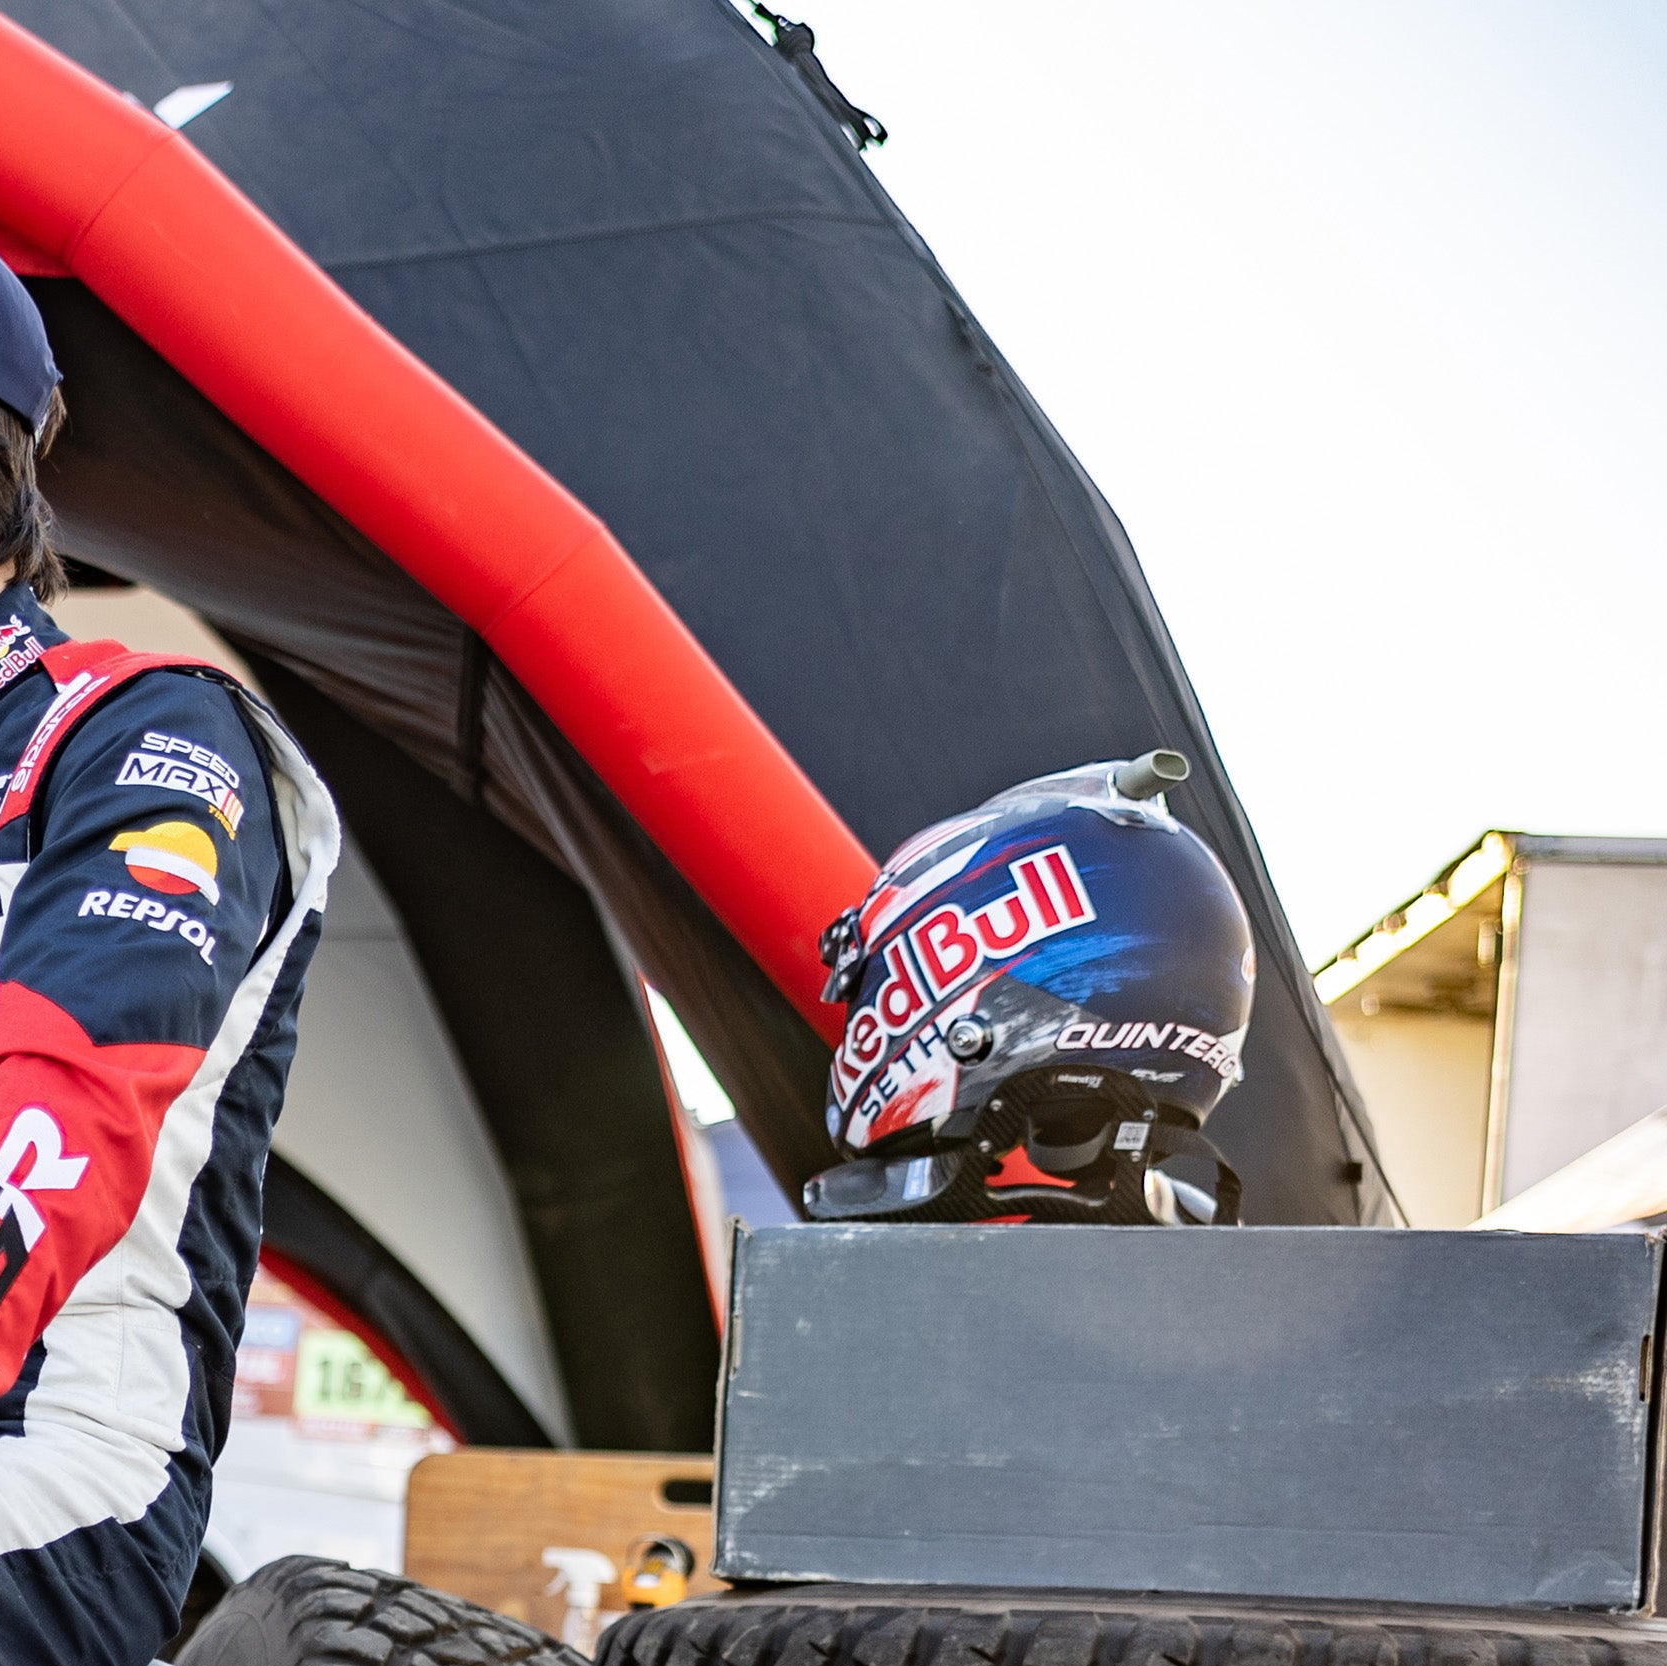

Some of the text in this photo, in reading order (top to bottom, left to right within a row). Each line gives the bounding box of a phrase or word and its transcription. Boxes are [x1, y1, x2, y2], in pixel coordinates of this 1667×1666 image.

[13, 636, 46, 672] Bull
[123, 758, 224, 803] MAX
[140, 732, 240, 789] SPEED
[77, 890, 215, 966] REPSOL
[916, 847, 1090, 992] Bull
[859, 1020, 946, 1123] SETH
[1055, 1021, 1241, 1079] QUINTERO
